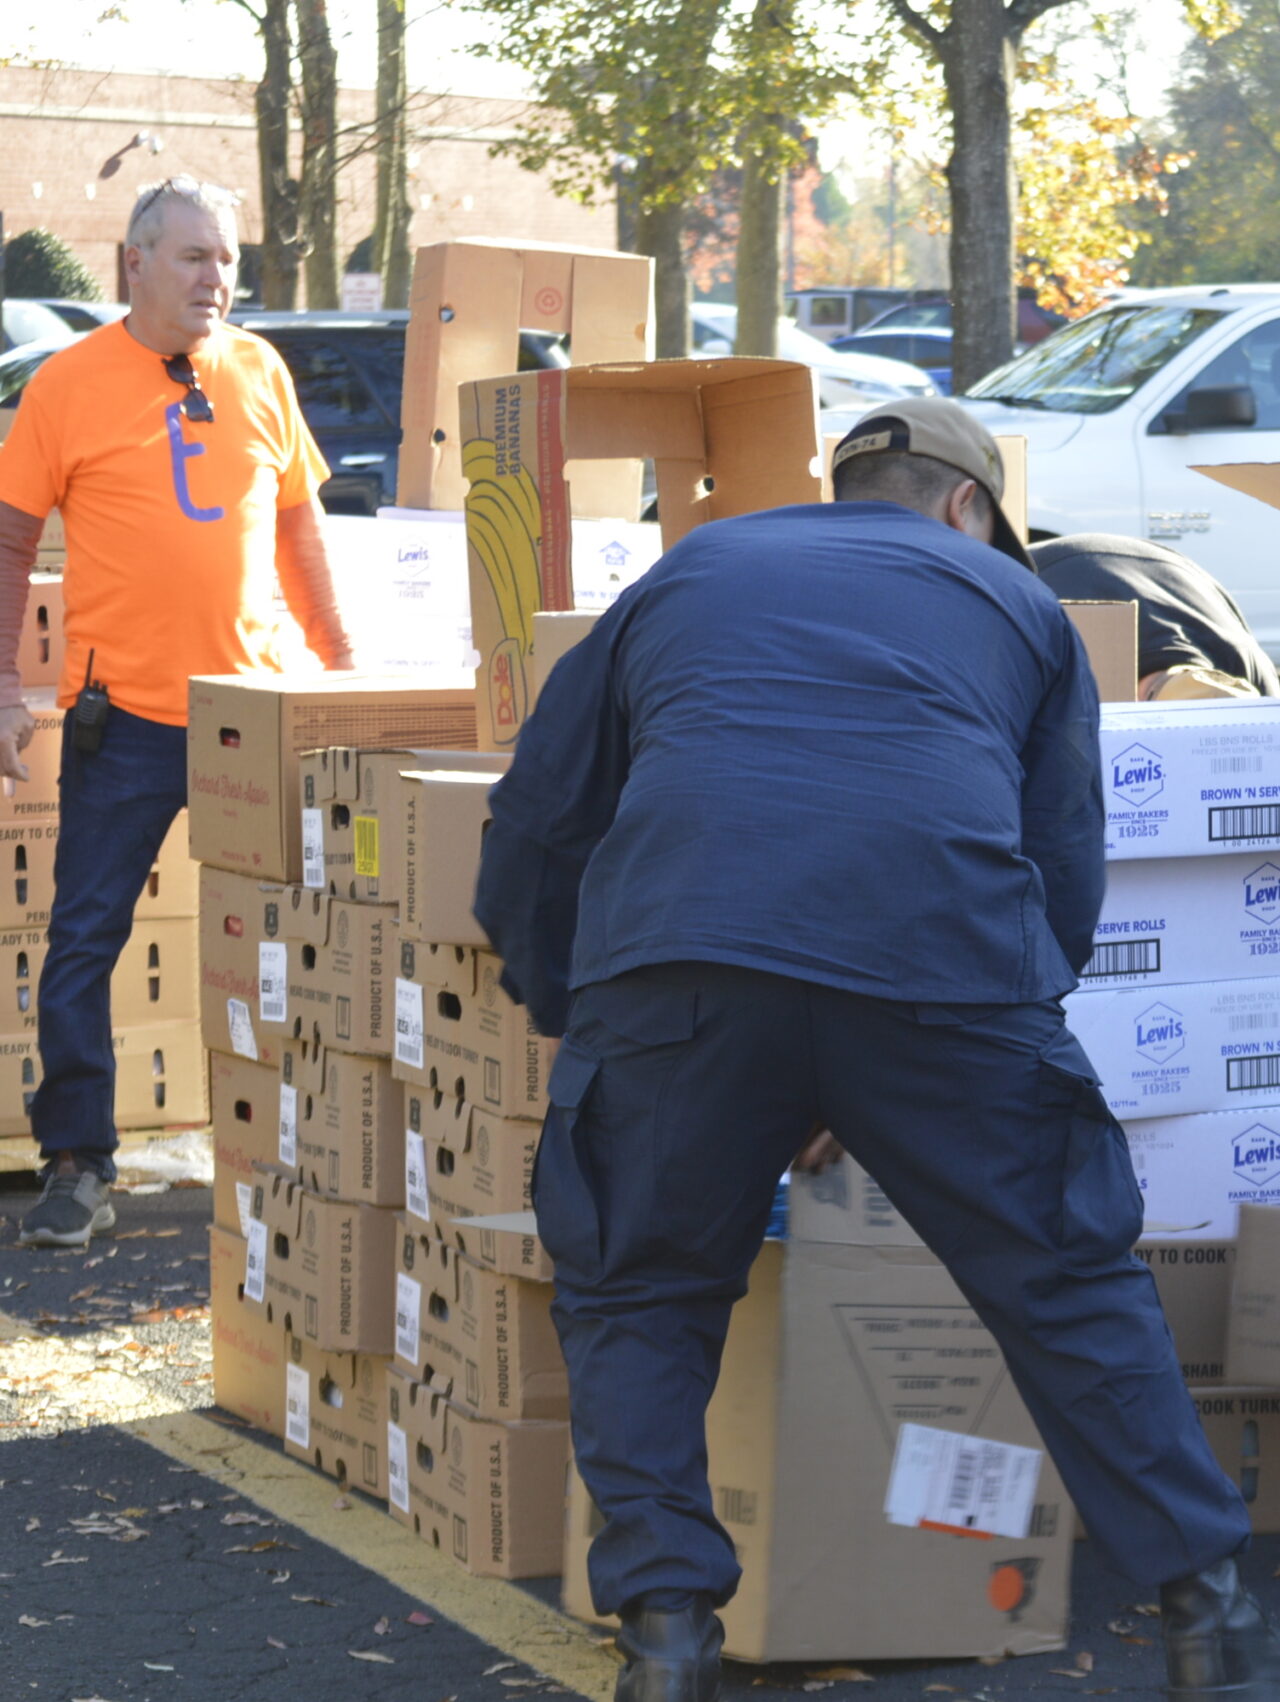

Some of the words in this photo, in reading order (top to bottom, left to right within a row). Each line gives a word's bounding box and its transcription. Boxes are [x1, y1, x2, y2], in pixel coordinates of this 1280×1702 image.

[495, 387, 508, 476] PREMIUM
[508, 384, 521, 476] BANANAS
[398, 547, 429, 564] Lewis
[493, 654, 514, 725] Dole
[1242, 734, 1273, 744] ROLLS
[1114, 760, 1162, 788] Lewis
[1200, 788, 1242, 801] BROWN
[14, 802, 60, 815] PERISHA
[1108, 812, 1136, 821] FAMILY
[1138, 810, 1169, 819] BAKERS
[0, 826, 24, 841] EADY
[28, 828, 42, 840] TO
[1118, 824, 1159, 839] 1925
[407, 838, 416, 856] OF
[407, 861, 416, 923] PRODUCT
[1097, 922, 1130, 935] SERVE
[1133, 919, 1166, 933] ROLLS
[1240, 930, 1267, 939] FAMILY
[371, 959, 383, 977] OF
[371, 980, 383, 1038] PRODUCT
[526, 1019, 536, 1036] OF
[1137, 1018, 1183, 1047] Lewis
[1221, 1043, 1260, 1057] BROWN
[527, 1040, 538, 1102] PRODUCT
[1131, 1070, 1159, 1079] FAMILY
[1161, 1066, 1190, 1076] BAKERS
[1142, 1081, 1181, 1096] 1925
[362, 1111, 373, 1127] OF
[362, 1132, 373, 1188] PRODUCT
[1228, 1190, 1258, 1200] FAMILY
[523, 1203, 536, 1265] PROT
[340, 1256, 351, 1273] OF
[1159, 1249, 1178, 1264] TO
[1184, 1249, 1226, 1264] COOK
[340, 1278, 351, 1335] PRODUCT
[496, 1326, 508, 1344] OF
[497, 1347, 509, 1408] PRODUCT
[490, 1482, 502, 1498] OF
[491, 1503, 503, 1563] PRODUCT
